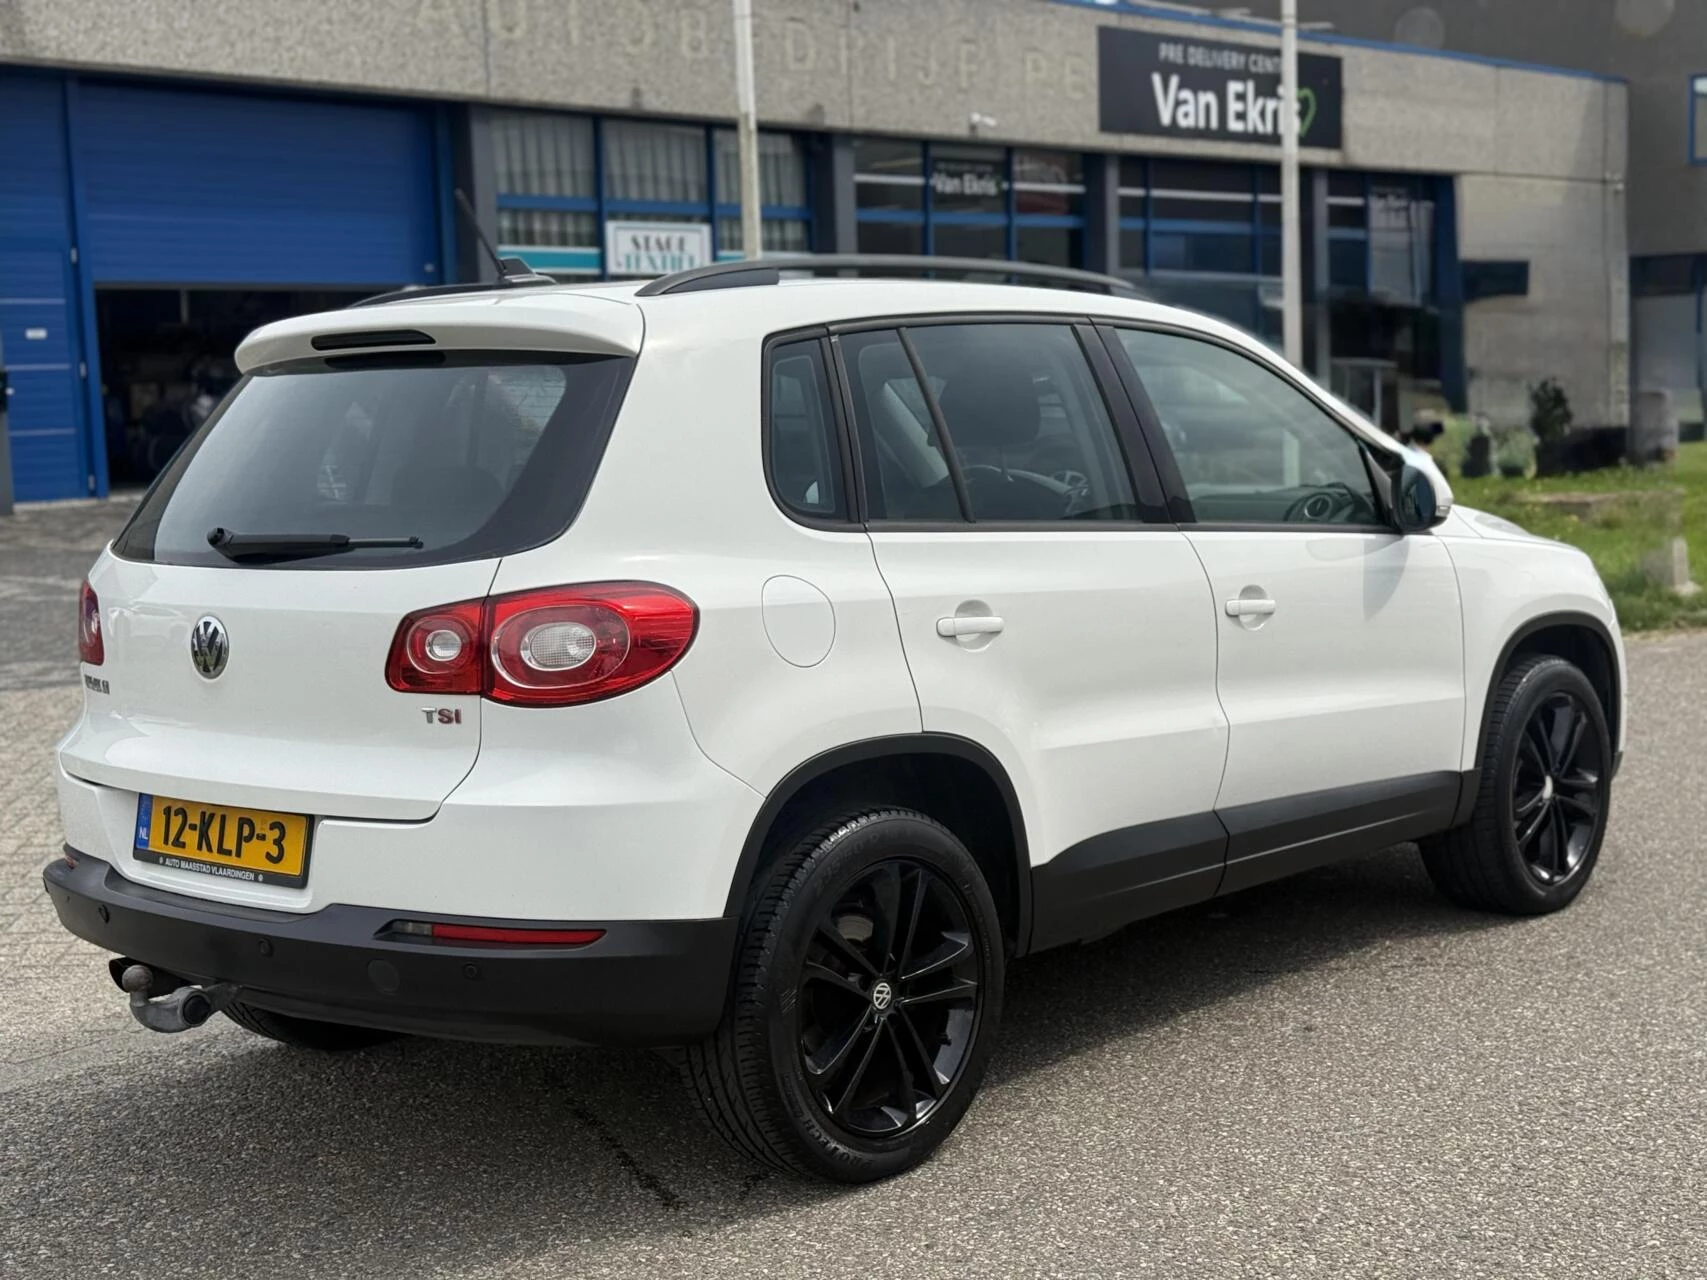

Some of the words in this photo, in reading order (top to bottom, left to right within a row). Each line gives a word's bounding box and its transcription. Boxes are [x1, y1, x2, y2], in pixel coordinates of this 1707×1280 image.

[1158, 42, 1184, 65] PRE
[1187, 45, 1246, 70] DELIVERY
[1248, 52, 1283, 75] CENT
[1151, 72, 1219, 130] Van
[421, 706, 462, 725] TSI
[138, 826, 149, 841] NL
[162, 805, 286, 864] 12-KLP-3
[165, 857, 180, 869] AUTO
[180, 860, 211, 874] MAASSTAD
[211, 866, 255, 881] VLAARDINGEN
